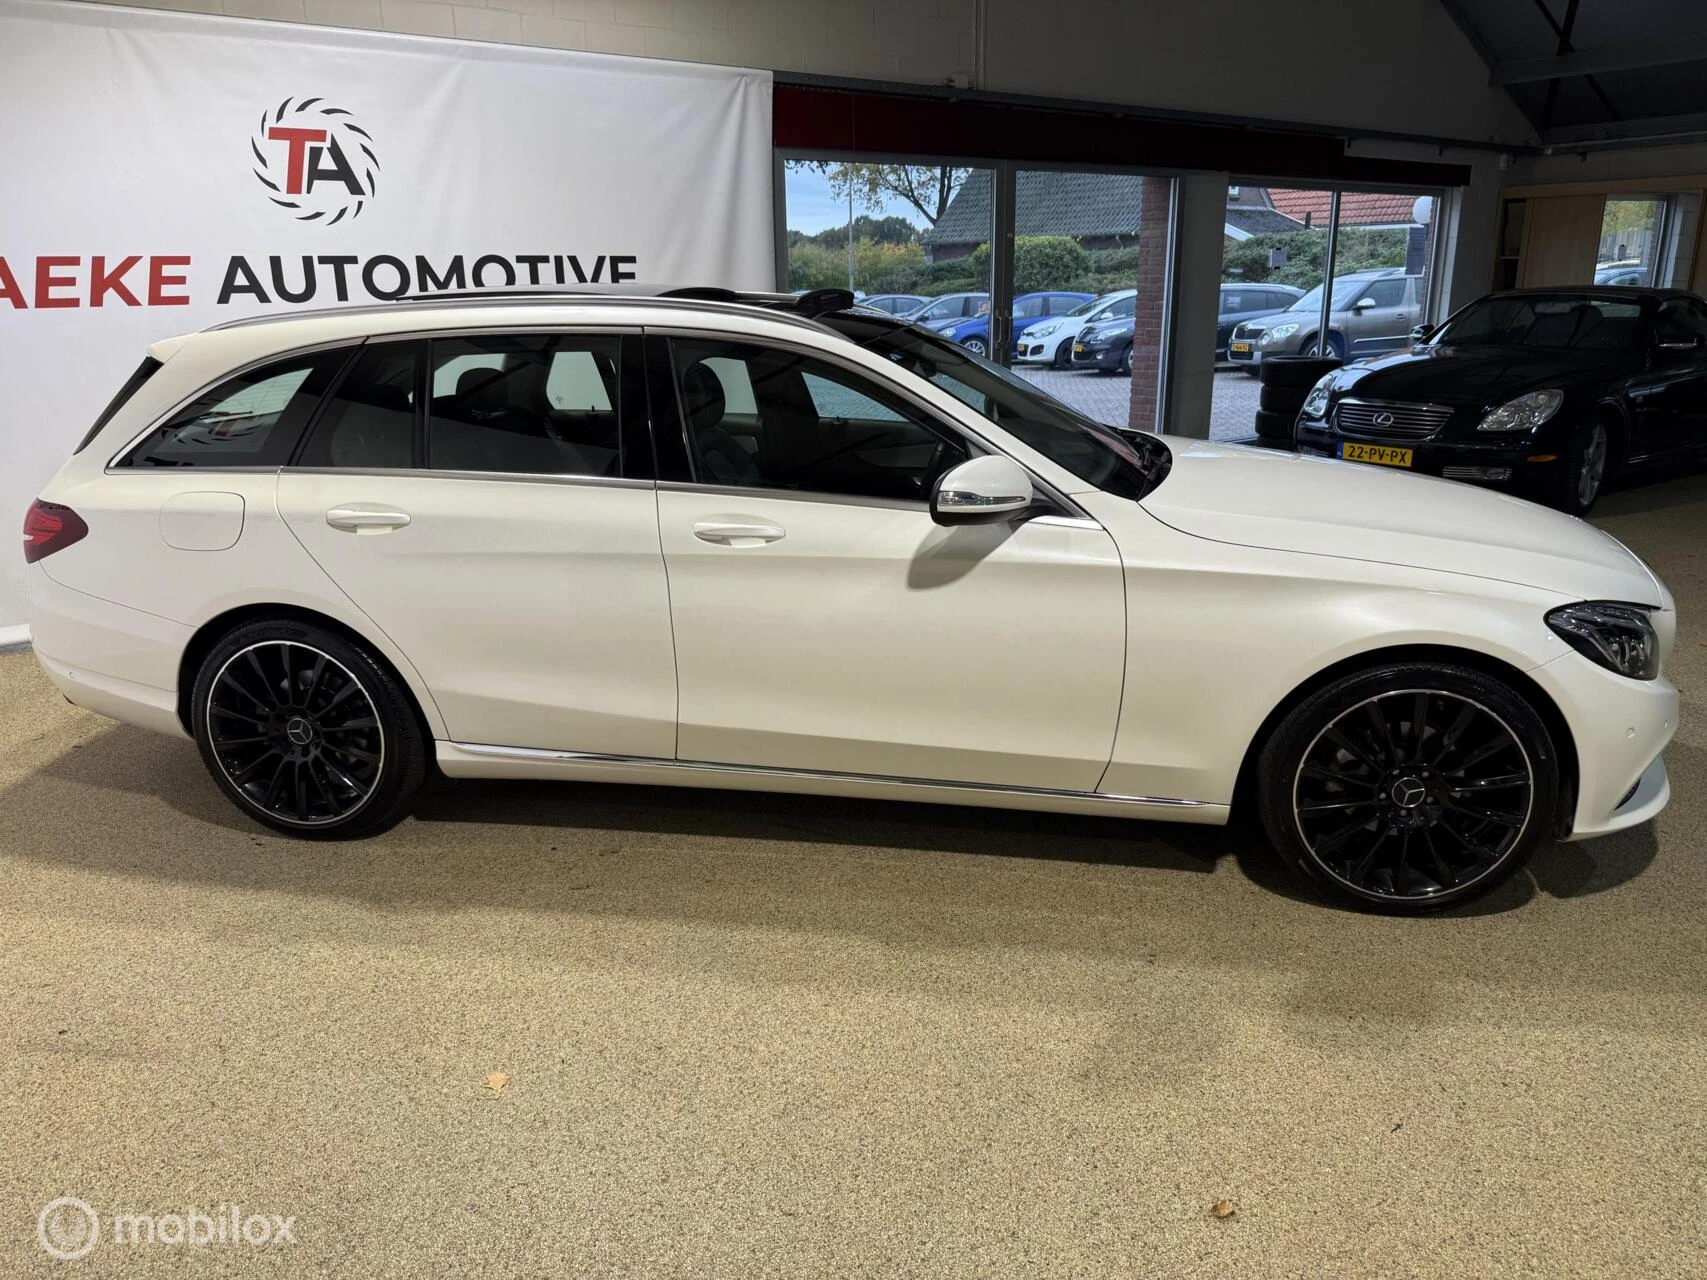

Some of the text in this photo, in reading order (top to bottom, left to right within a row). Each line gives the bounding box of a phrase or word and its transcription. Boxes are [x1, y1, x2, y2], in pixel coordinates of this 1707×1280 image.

[268, 126, 366, 195] TA
[216, 253, 637, 304] AUTOMOTIVE
[1347, 444, 1408, 465] 22-PV-PX
